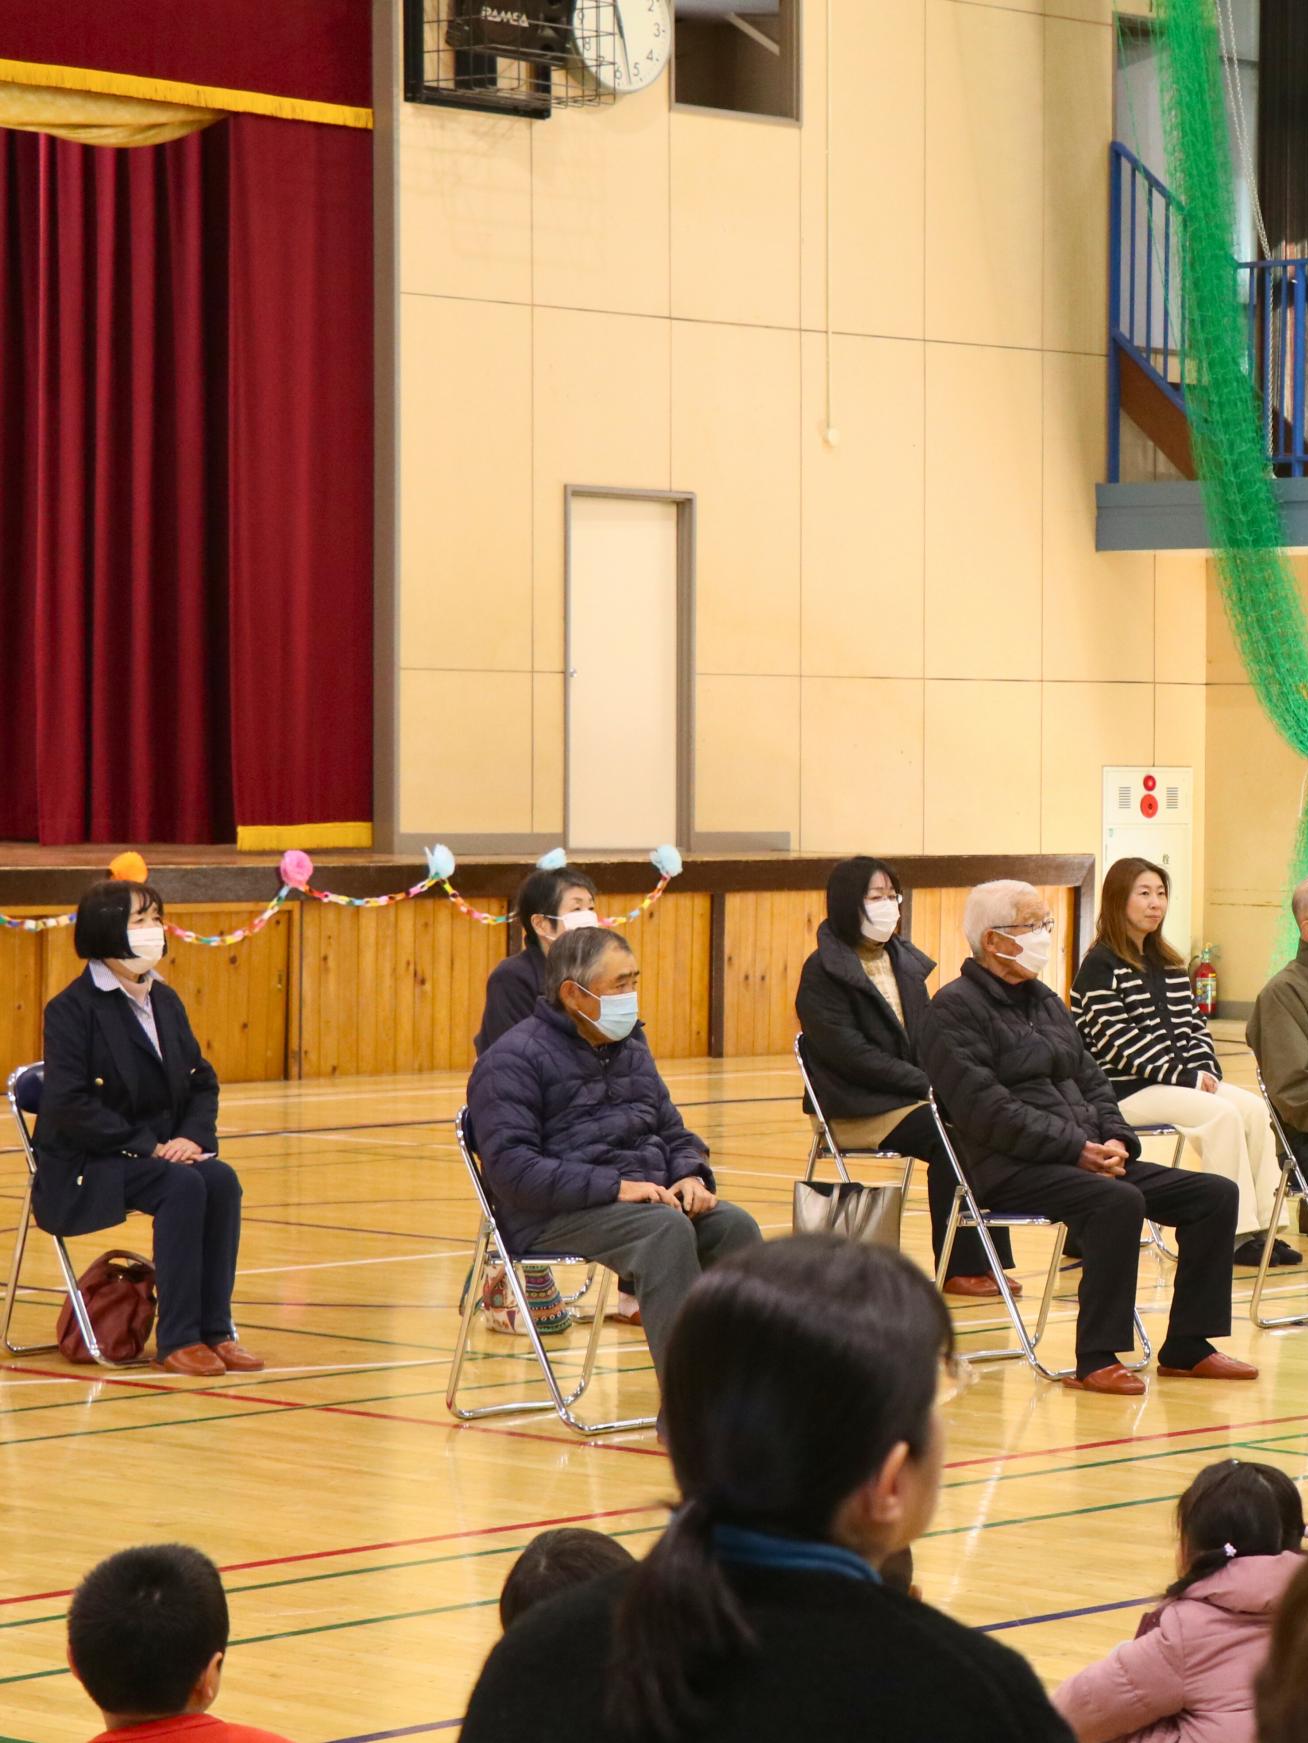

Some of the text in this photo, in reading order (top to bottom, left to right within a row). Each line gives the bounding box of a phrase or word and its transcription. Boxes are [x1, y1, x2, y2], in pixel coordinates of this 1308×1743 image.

[653, 22, 660, 37] 3
[646, 49, 654, 62] 4
[614, 65, 622, 80] 6
[632, 62, 640, 77] 5
